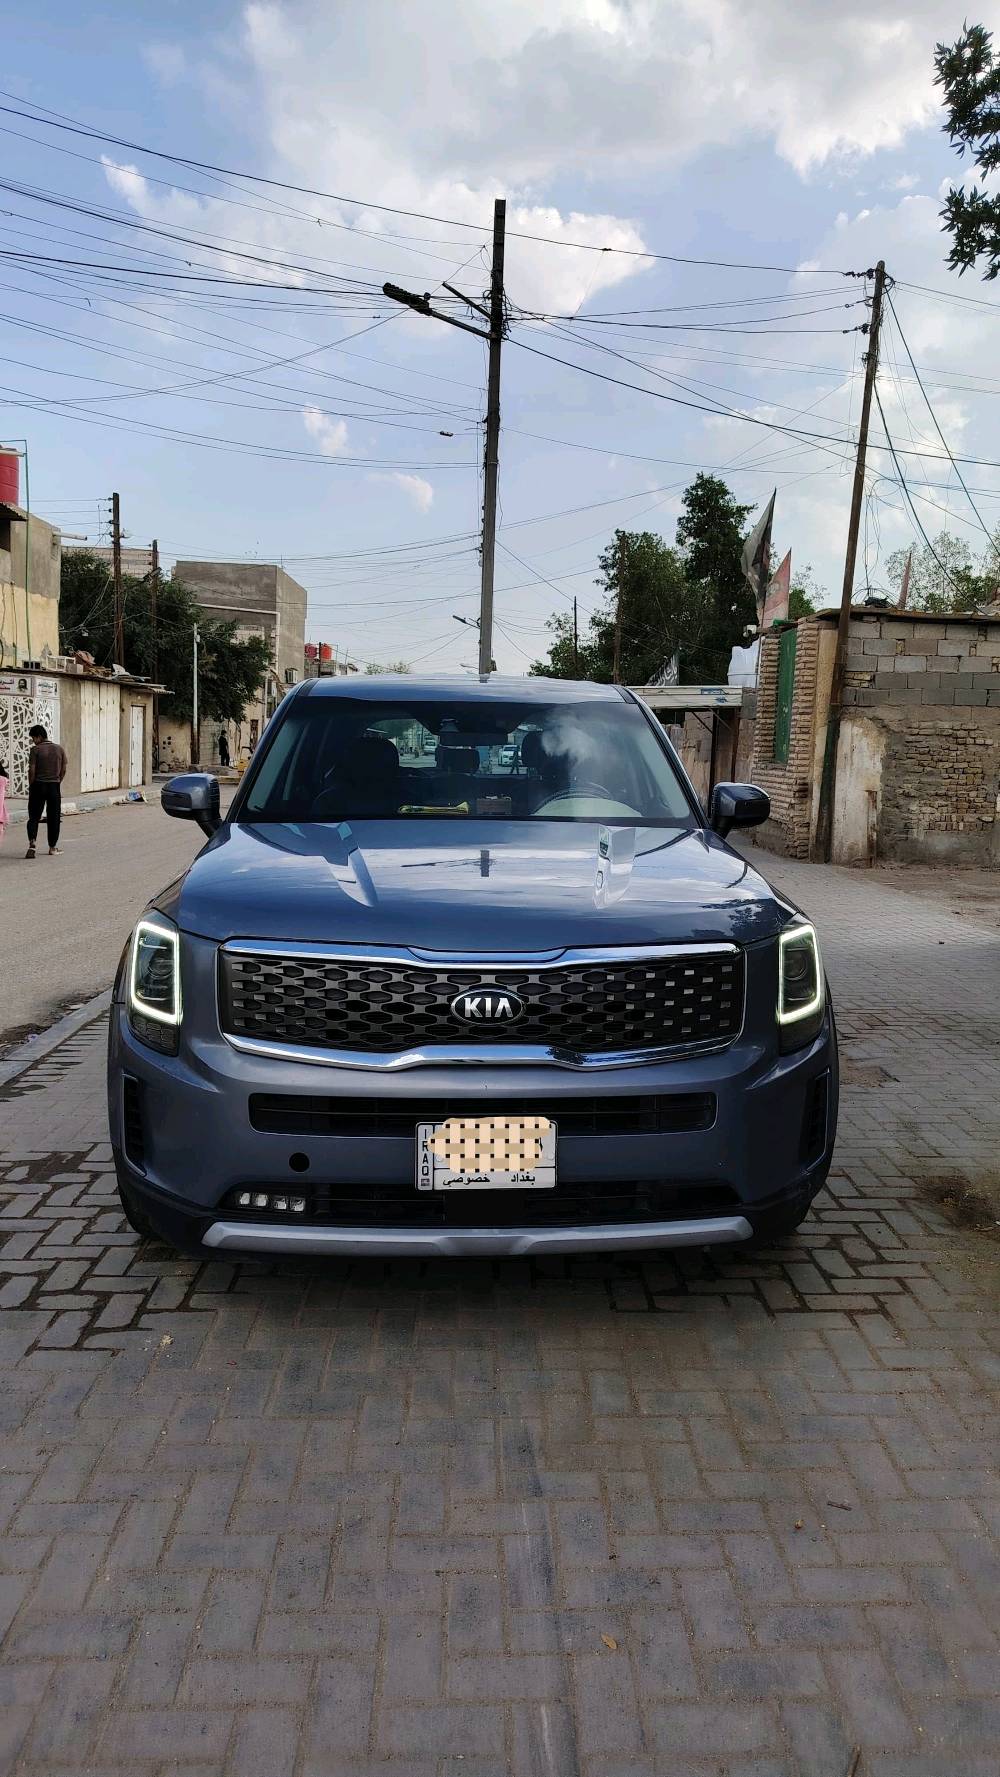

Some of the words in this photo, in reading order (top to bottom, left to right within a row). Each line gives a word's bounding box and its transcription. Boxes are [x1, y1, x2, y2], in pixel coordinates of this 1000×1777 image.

[464, 997, 514, 1018] KIA
[421, 1128, 430, 1177] IRAQ
[442, 1173, 491, 1186] خصوصي
[511, 1171, 536, 1186] بغداد
